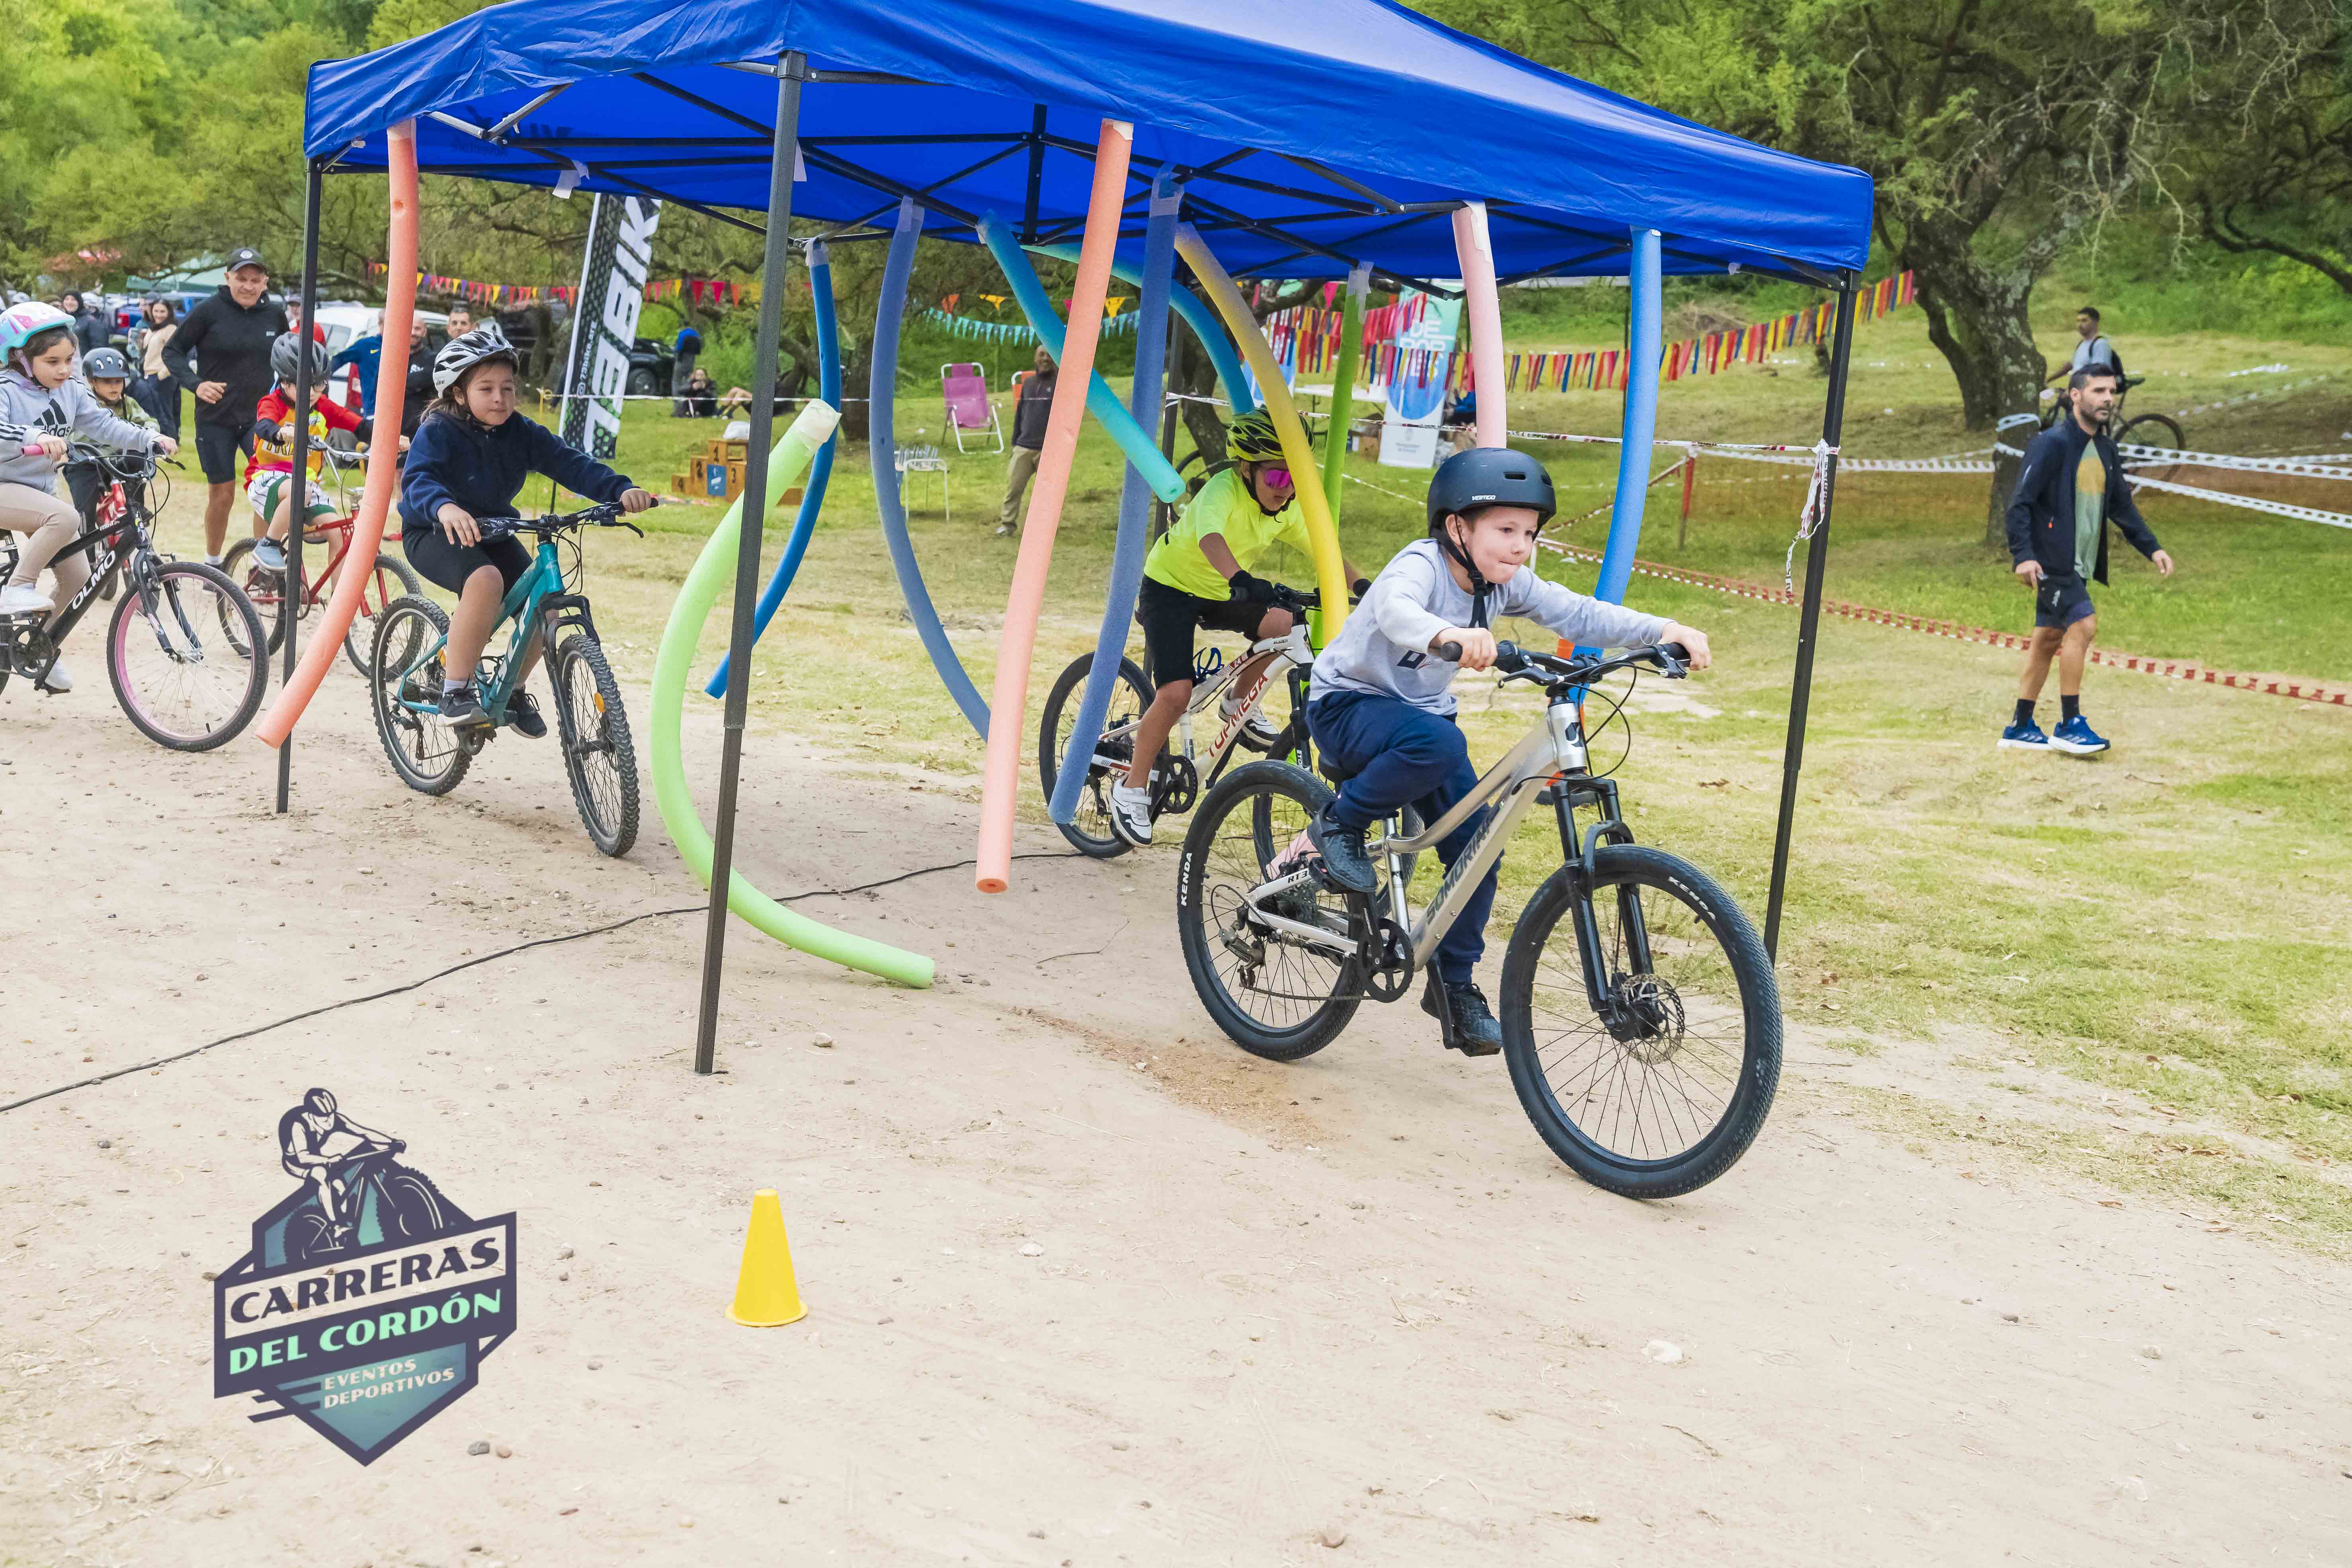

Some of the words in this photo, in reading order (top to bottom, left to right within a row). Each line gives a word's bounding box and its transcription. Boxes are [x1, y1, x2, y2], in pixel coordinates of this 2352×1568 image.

[583, 196, 662, 457] 73BIK
[714, 446, 719, 462] 1
[72, 550, 116, 610] OLMO
[1204, 675, 1268, 758] TOPMEGA
[1181, 852, 1193, 907] KENDA
[1287, 870, 1308, 884] RT3
